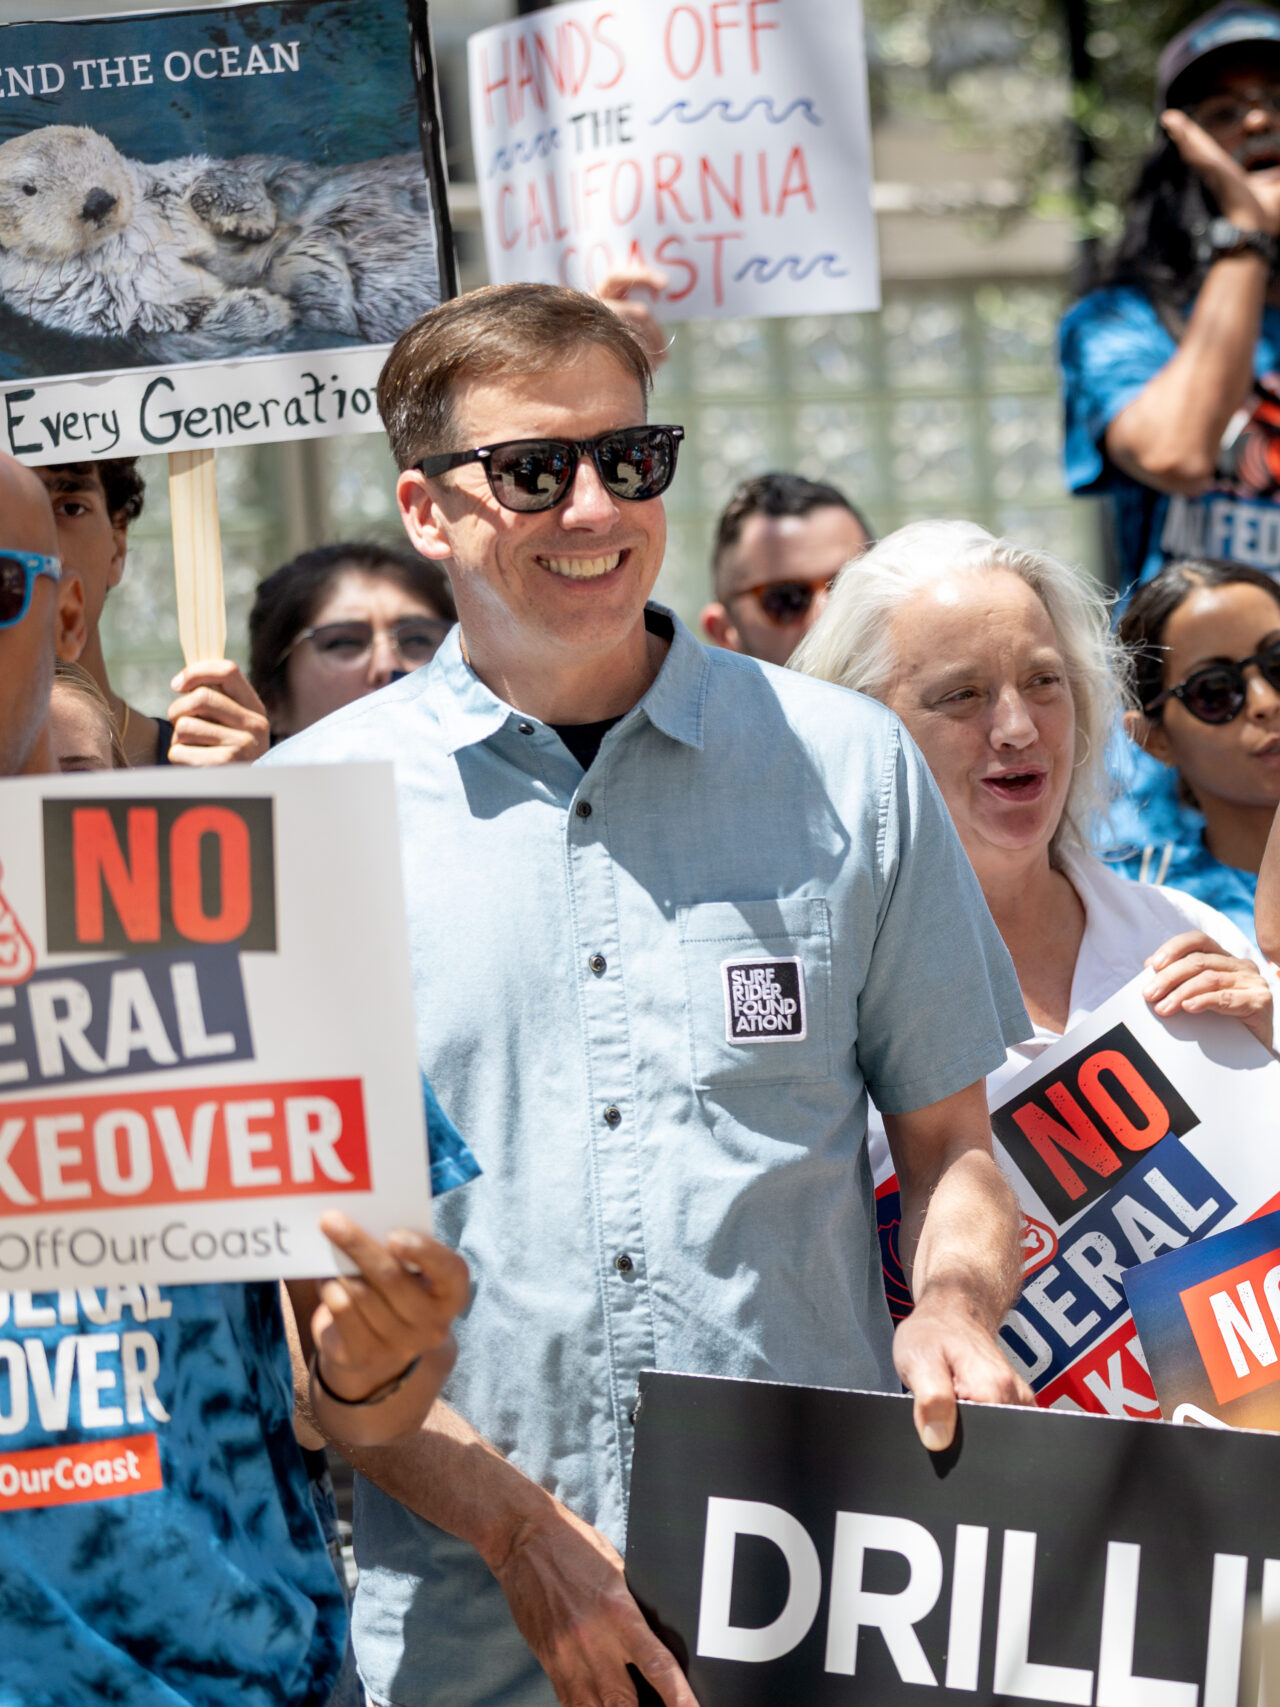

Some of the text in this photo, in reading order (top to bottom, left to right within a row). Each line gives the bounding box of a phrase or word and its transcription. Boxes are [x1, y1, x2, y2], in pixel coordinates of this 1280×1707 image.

[0, 41, 300, 98] ND THE OCEAN
[481, 0, 780, 127] HANDS OFF
[568, 103, 634, 154] THE
[497, 143, 817, 251] CALIFORNIA
[4, 372, 379, 455] Every Generatio
[71, 805, 253, 944] NO
[731, 968, 775, 987] SURF
[732, 983, 783, 1002] RIDER
[734, 998, 797, 1017] FOUND
[736, 1014, 793, 1032] ATION
[1011, 1049, 1170, 1201] NO
